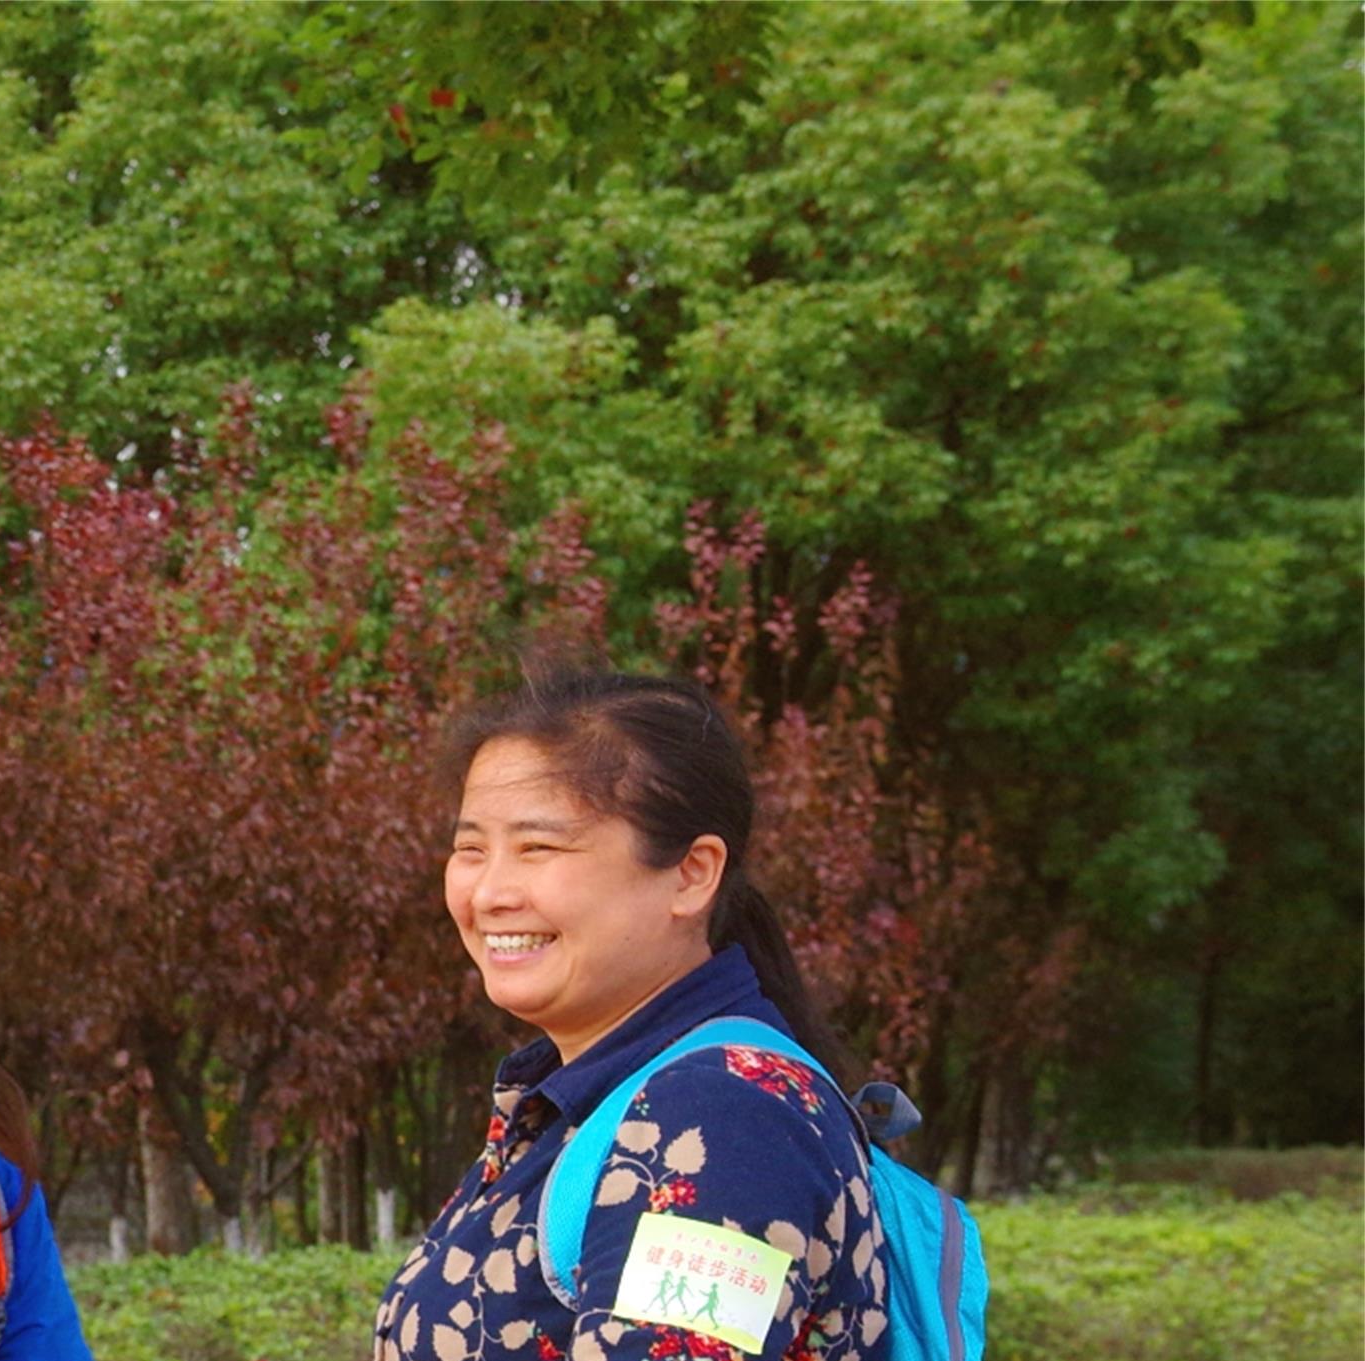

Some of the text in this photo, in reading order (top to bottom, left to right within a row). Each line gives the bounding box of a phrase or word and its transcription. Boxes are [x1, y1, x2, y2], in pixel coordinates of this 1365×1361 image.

[646, 1245, 768, 1296] 健身徒步活动
